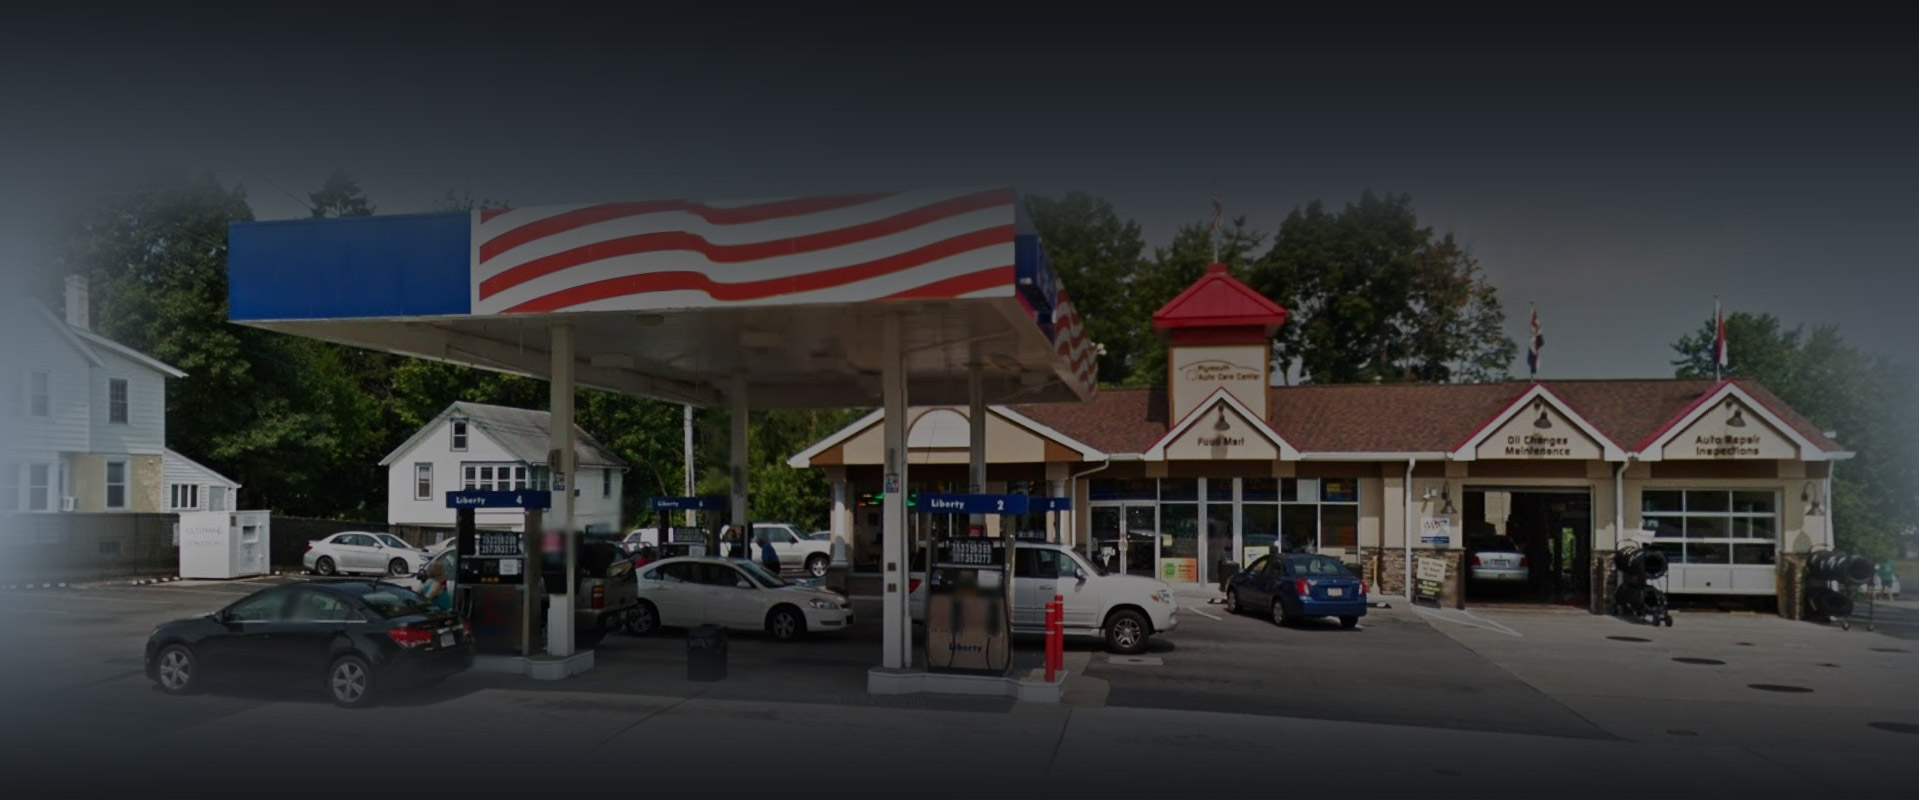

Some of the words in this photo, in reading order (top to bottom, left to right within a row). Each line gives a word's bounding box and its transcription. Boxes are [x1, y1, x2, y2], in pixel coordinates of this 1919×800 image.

[1198, 365, 1230, 373] Plymouth
[1197, 437, 1221, 447] Food
[1223, 436, 1245, 446] Mart
[1507, 436, 1520, 445] Oil
[1524, 436, 1568, 447] Changes
[1696, 435, 1722, 445] Auto
[1725, 435, 1760, 446] Repair
[1505, 446, 1570, 455] Maintenance
[1696, 446, 1759, 456] Inspections
[455, 496, 486, 505] Liberty
[515, 495, 523, 505] 4
[657, 500, 679, 508] Liberty
[931, 498, 965, 510] Liberty
[997, 499, 1005, 511] 2
